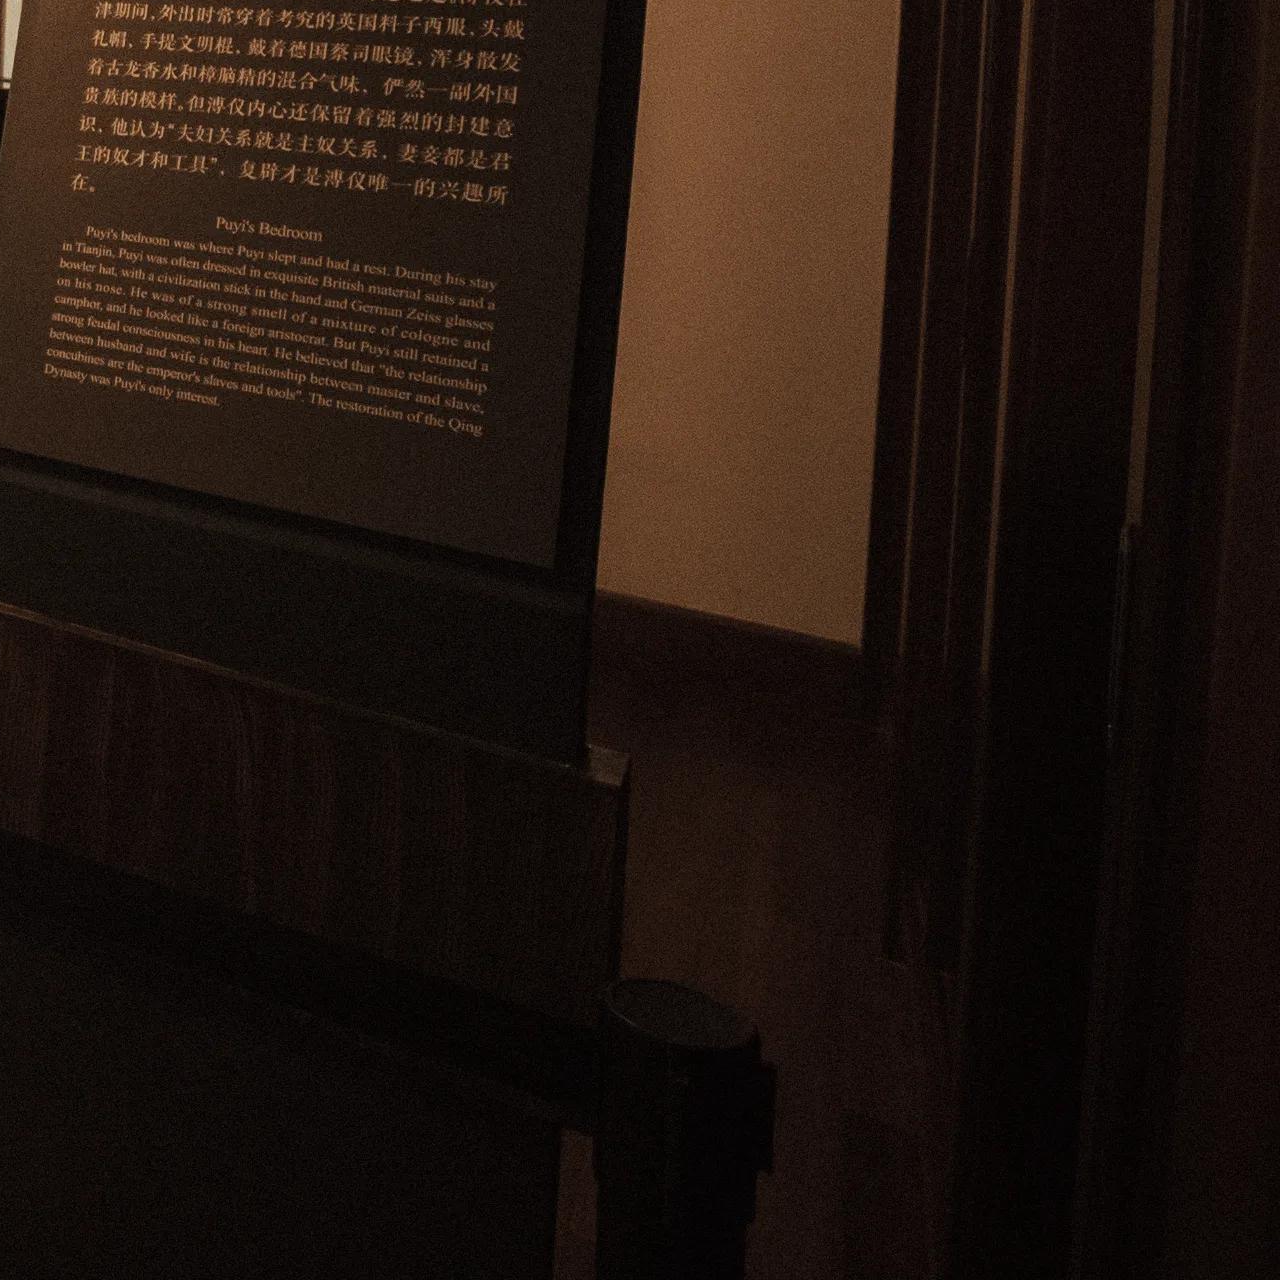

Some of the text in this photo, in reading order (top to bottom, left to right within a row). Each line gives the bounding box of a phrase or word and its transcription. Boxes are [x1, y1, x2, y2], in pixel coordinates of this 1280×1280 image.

[70, 173, 96, 193] 在。
[86, 225, 118, 241] Puyi's
[120, 230, 170, 247] bedroom
[173, 239, 196, 250] was
[199, 241, 234, 256] where
[237, 245, 265, 261] Puyi
[267, 250, 297, 266] slept
[299, 255, 323, 267] and
[326, 256, 350, 271] had
[352, 263, 360, 273] a
[395, 265, 442, 285] During
[445, 272, 466, 286] his
[469, 278, 498, 292] stay
[216, 216, 323, 242] Puyi's Bedroom
[59, 257, 96, 273] bowler
[121, 268, 146, 280] with
[147, 272, 155, 282] a
[157, 273, 221, 291] civilization
[223, 283, 251, 296] stick
[254, 288, 266, 298] in
[269, 288, 289, 301] the
[291, 291, 322, 306] hand
[324, 298, 348, 310] and
[350, 300, 403, 318] German
[406, 308, 442, 323] Zeiss
[445, 314, 494, 331] glasses
[61, 241, 73, 252] in
[118, 247, 143, 264] Puyi
[146, 254, 168, 265] was
[170, 256, 200, 270] often
[202, 259, 247, 276] dressed
[249, 268, 261, 278] in
[263, 271, 319, 286] exquisite
[322, 275, 365, 292] British
[368, 285, 421, 300] material
[424, 293, 455, 306] suits
[458, 297, 484, 309] and
[487, 301, 496, 311] a
[56, 277, 71, 288] on
[74, 277, 92, 290] his
[130, 286, 148, 299] He
[151, 292, 175, 303] was
[178, 294, 195, 306] of
[195, 298, 203, 308] a
[207, 300, 247, 317] strong
[251, 307, 287, 320] smell
[291, 311, 308, 324] of
[309, 315, 318, 325] a
[321, 318, 377, 334] mixture
[380, 325, 399, 337] of
[400, 329, 459, 347] cologne
[463, 339, 491, 352] and
[105, 303, 127, 314] and
[129, 304, 143, 317] he
[145, 306, 185, 324] looked
[187, 313, 209, 327] like
[211, 320, 219, 329] a
[222, 319, 265, 338] foreign
[333, 336, 356, 350] But
[360, 340, 390, 358] Puyi
[393, 348, 419, 361] still
[422, 353, 478, 370] retained
[481, 363, 489, 373] a
[44, 363, 88, 384] Dynasty
[90, 374, 111, 386] was
[113, 376, 146, 392] Puyi's
[148, 385, 174, 400] only
[49, 327, 94, 345] between
[96, 335, 144, 354] husband
[145, 347, 167, 358] and
[170, 351, 196, 364] wife
[198, 356, 209, 366] is
[212, 356, 231, 370] the
[234, 361, 307, 385] relationship
[310, 372, 363, 392] between
[367, 385, 412, 401] master
[415, 394, 441, 406] and
[51, 312, 85, 328] strong
[87, 315, 120, 331] feudal
[122, 325, 201, 345] consciousness
[203, 338, 215, 347] in
[218, 337, 236, 350] his
[274, 346, 293, 360] He
[295, 350, 348, 370] believed
[351, 360, 375, 374] that
[408, 371, 488, 394] relationship
[46, 348, 105, 366] concubines
[107, 359, 125, 370] are
[126, 360, 144, 373] the
[146, 367, 201, 383] emperor's
[203, 374, 239, 390] slaves
[241, 383, 264, 395] and
[308, 392, 333, 408] The
[336, 400, 404, 420] restoration
[406, 411, 424, 424] of
[424, 413, 445, 428] the
[448, 418, 483, 437] Qing
